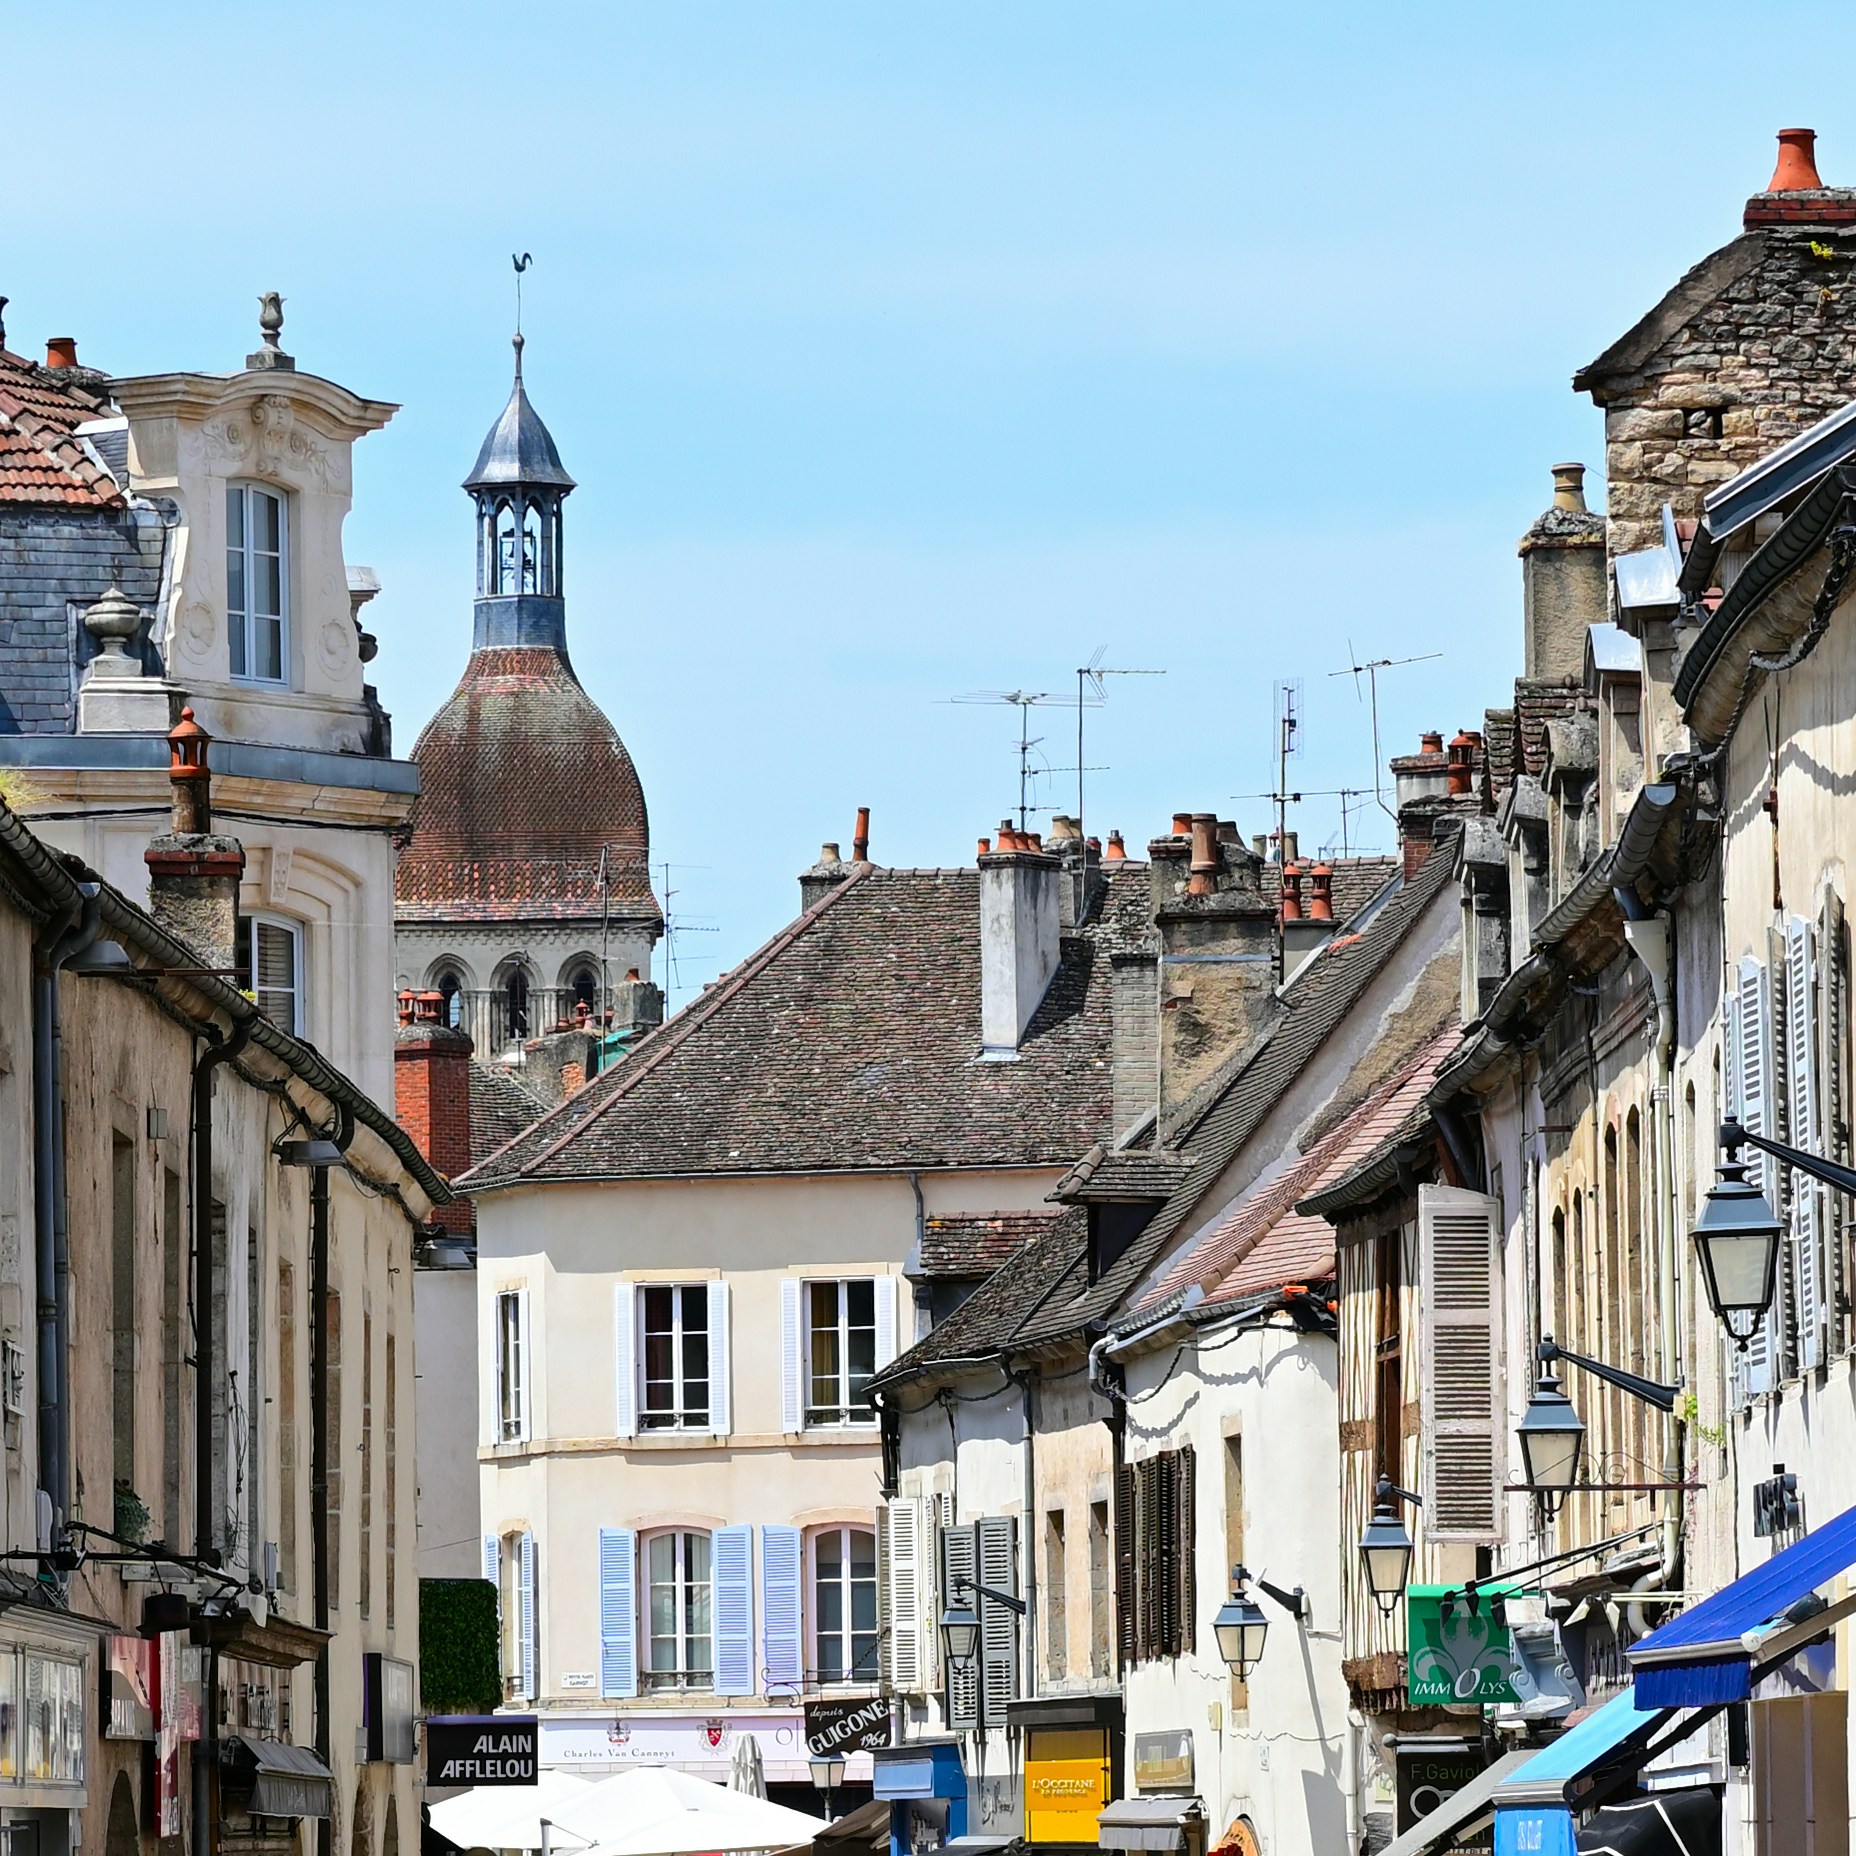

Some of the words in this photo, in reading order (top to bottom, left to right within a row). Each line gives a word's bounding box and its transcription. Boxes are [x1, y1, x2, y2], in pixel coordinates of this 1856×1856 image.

[1414, 1668, 1507, 1698] IMMOLYS
[810, 1705, 844, 1722] depuis
[808, 1698, 889, 1755] GUIGONE
[472, 1735, 533, 1754] ALAIN
[859, 1730, 887, 1748] 1964
[564, 1749, 603, 1758] Charles
[607, 1748, 626, 1757] Van
[631, 1748, 675, 1759] Canneyt
[440, 1759, 533, 1778] AFFLELOU
[1032, 1777, 1095, 1789] L'OCCITANE
